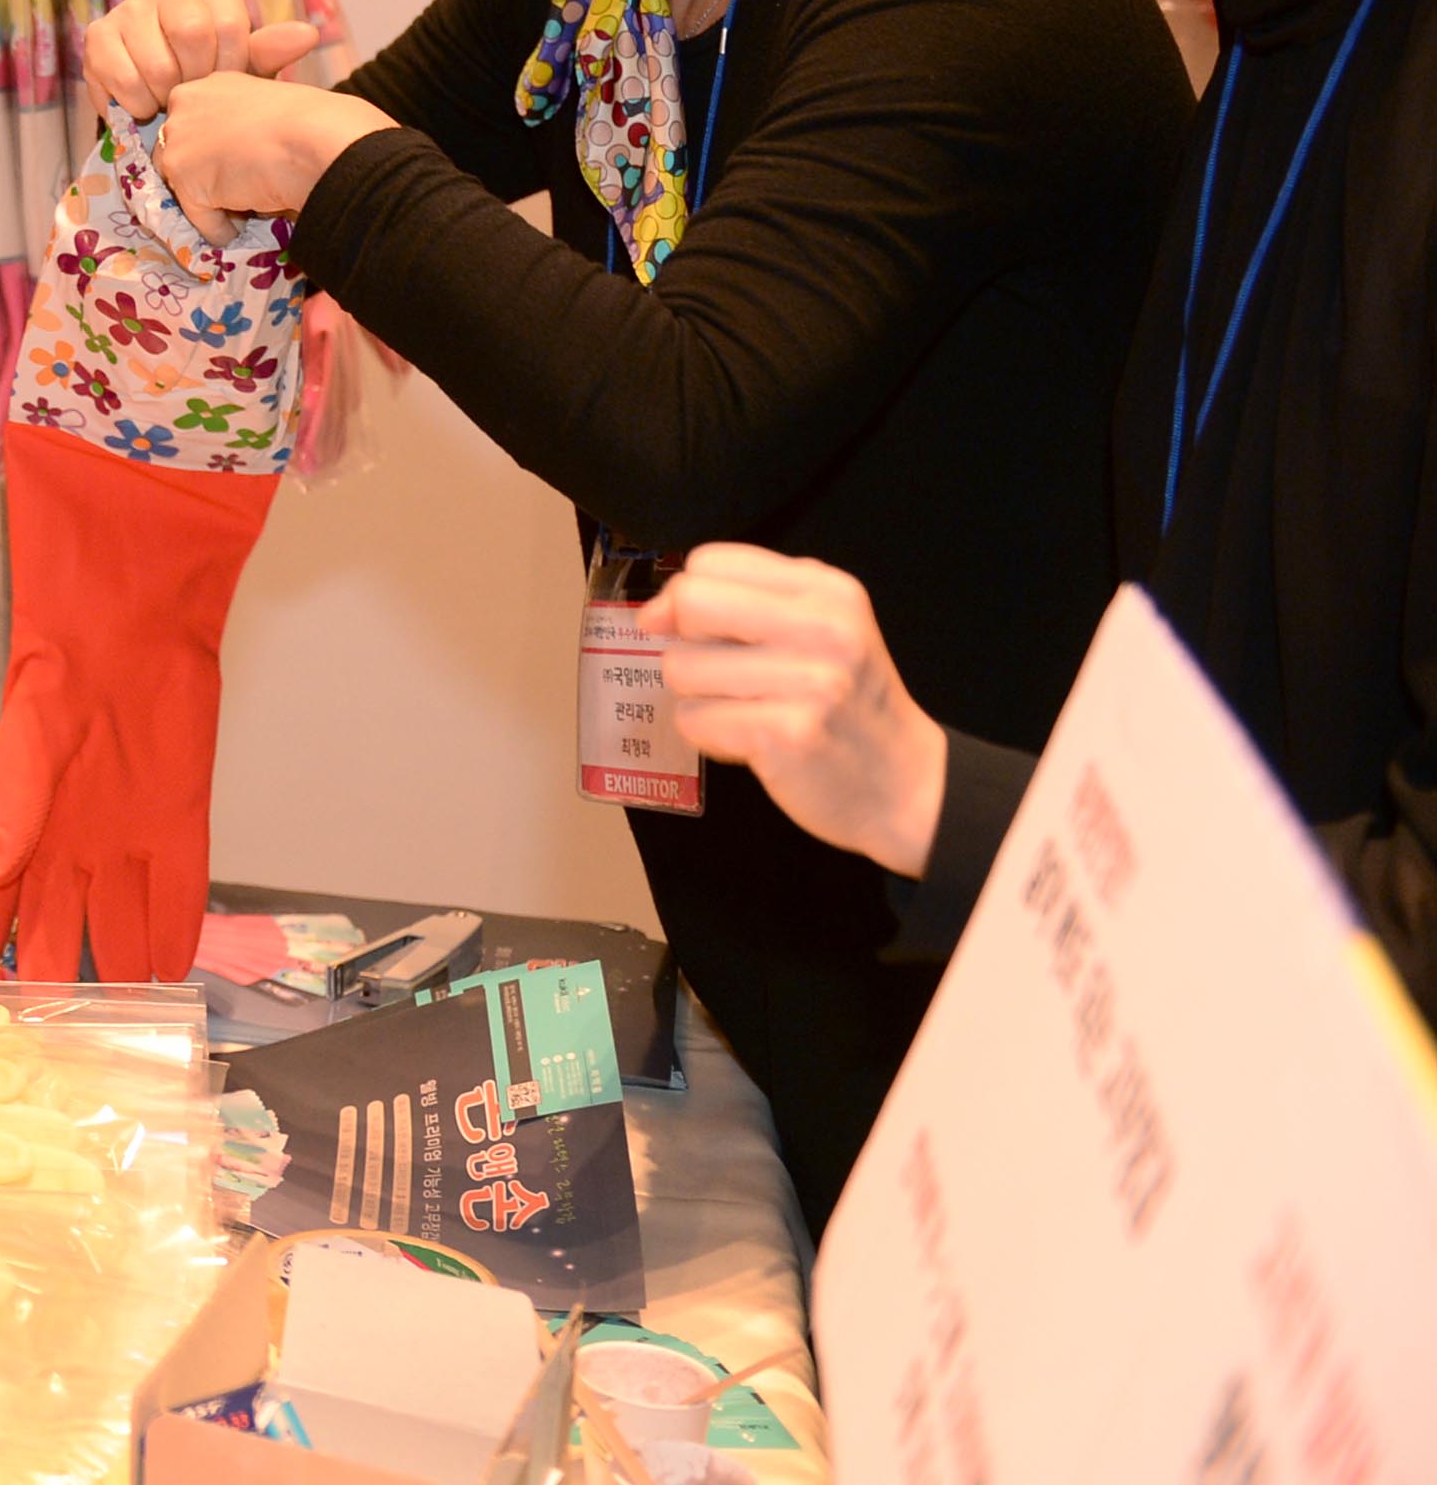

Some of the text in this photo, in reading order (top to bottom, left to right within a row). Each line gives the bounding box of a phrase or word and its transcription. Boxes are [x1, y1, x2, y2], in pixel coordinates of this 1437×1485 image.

[603, 772, 680, 800] EXHIBITOR
[423, 1112, 443, 1162] 프리미엄
[423, 1167, 443, 1199] 기능성
